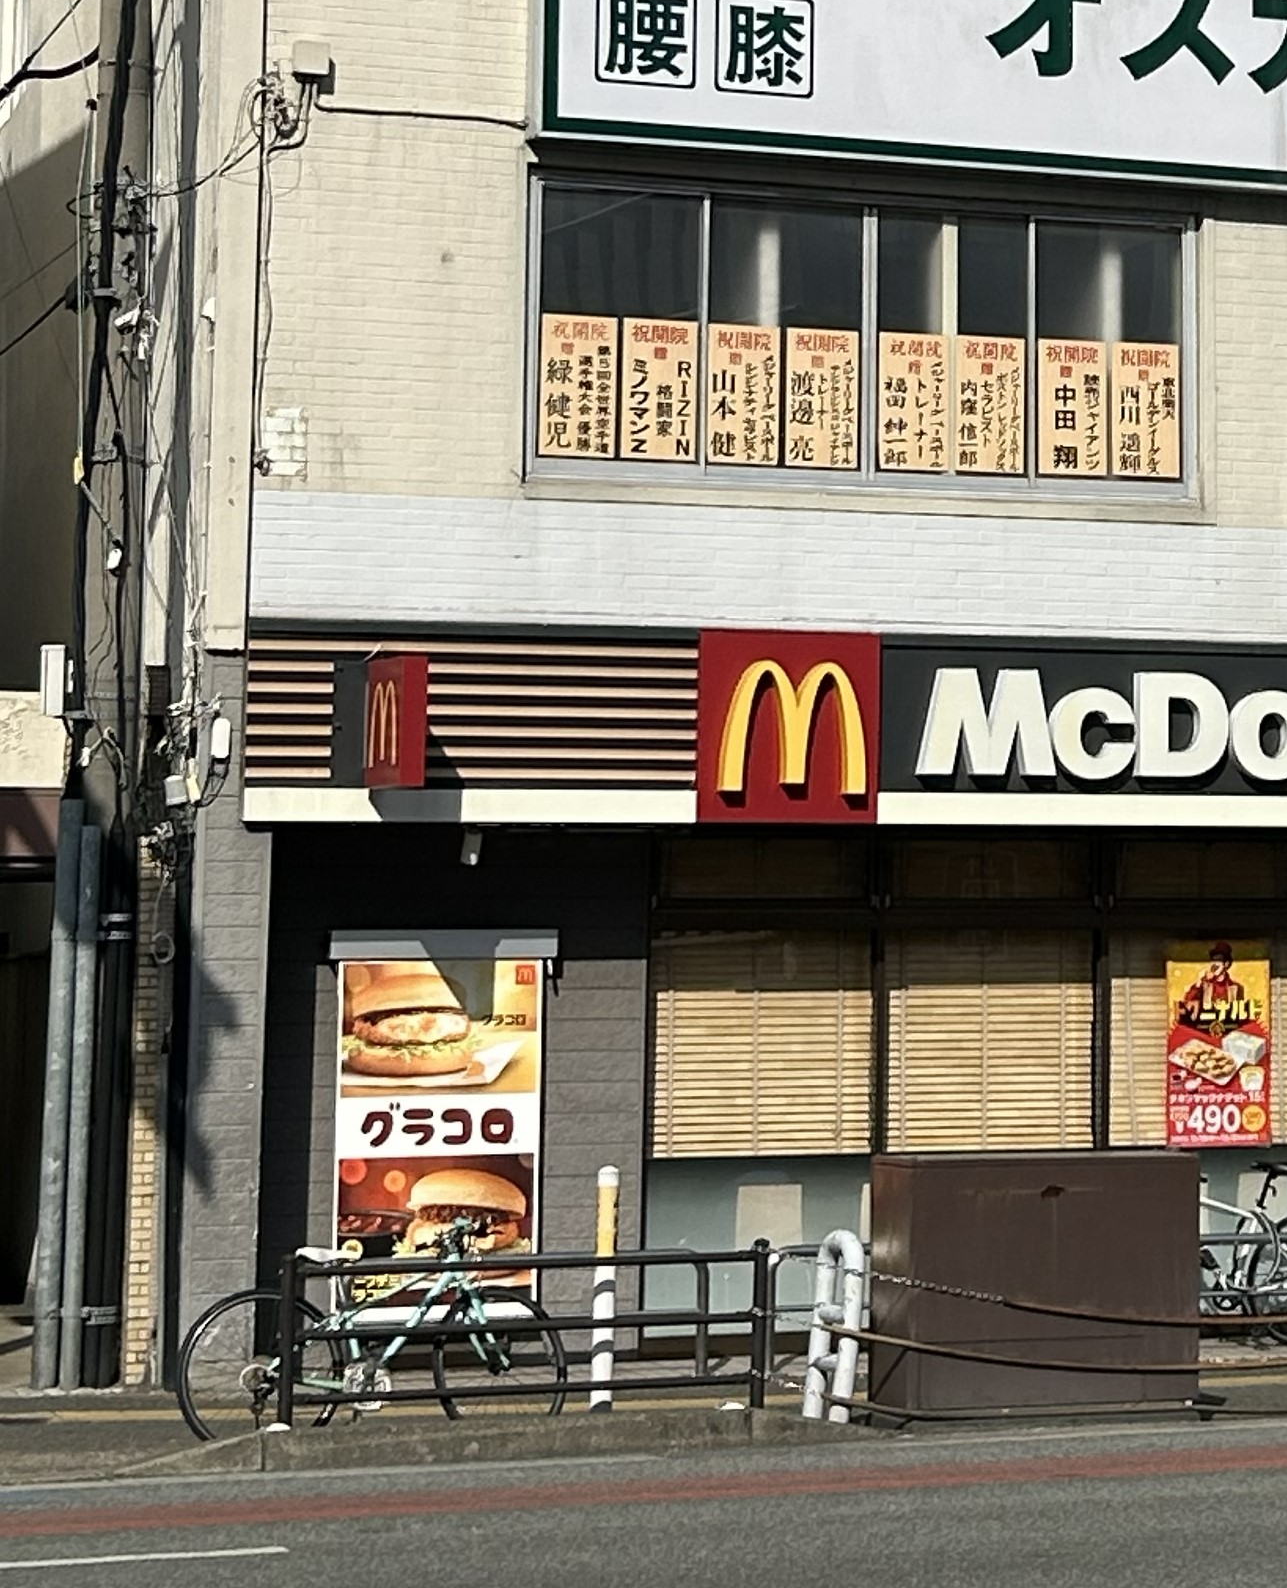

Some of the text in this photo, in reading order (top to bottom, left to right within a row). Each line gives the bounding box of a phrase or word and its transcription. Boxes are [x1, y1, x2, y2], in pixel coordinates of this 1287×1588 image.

[725, 5, 807, 88] 膝
[629, 358, 650, 454] ミノワマンZ
[676, 361, 692, 457] RIZIN
[914, 378, 929, 460] トレーナー
[1053, 383, 1078, 470] 中田翔
[361, 1103, 514, 1147] グラコロ
